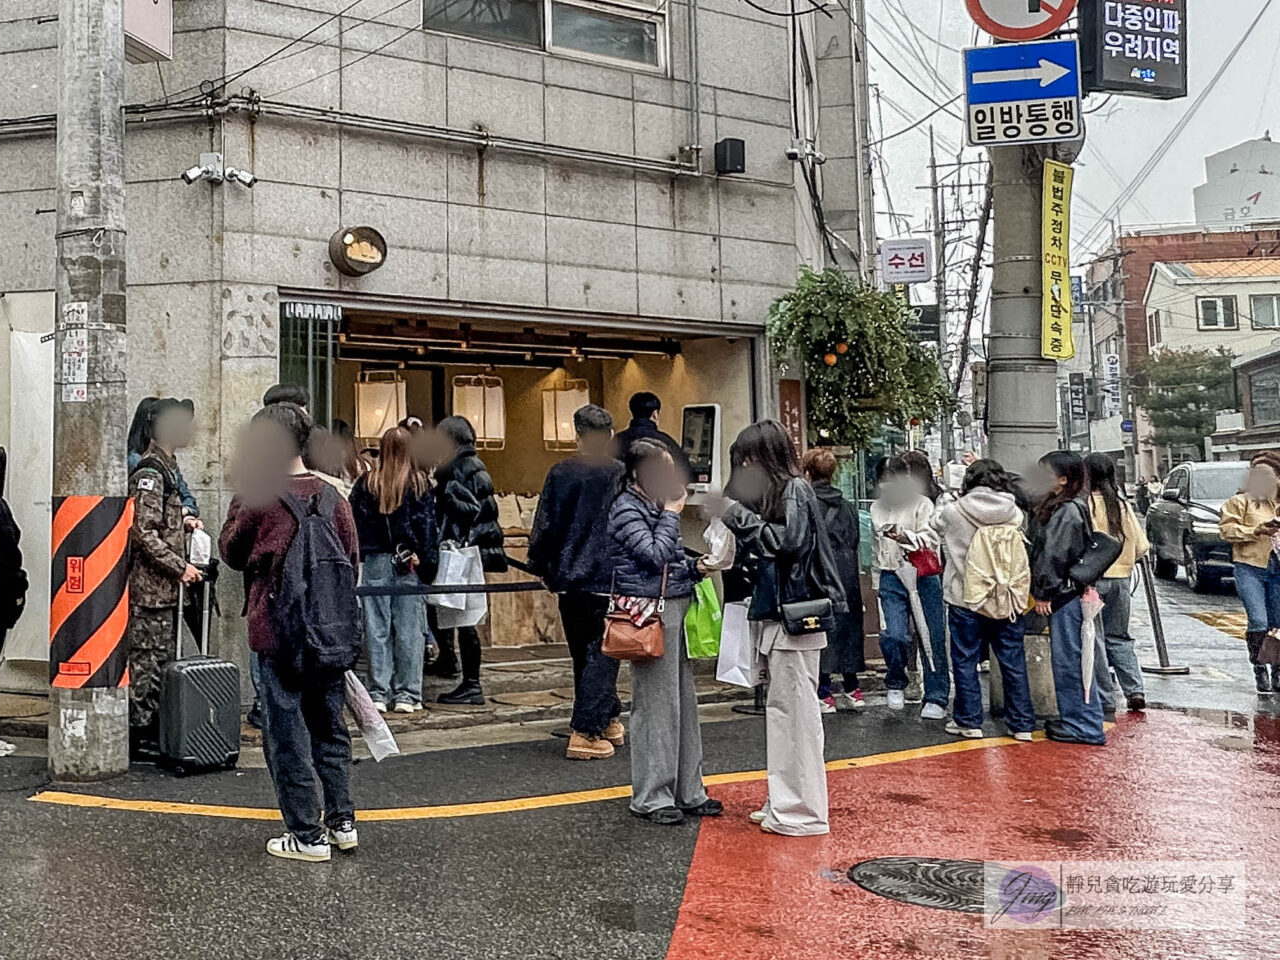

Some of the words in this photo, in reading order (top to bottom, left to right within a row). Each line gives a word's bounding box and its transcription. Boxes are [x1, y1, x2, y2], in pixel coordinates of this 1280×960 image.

[1104, 1, 1181, 35] 다중인파
[1104, 31, 1180, 65] 우려지역
[974, 100, 1074, 140] 일방통행
[1050, 168, 1066, 251] 불법주정차
[888, 252, 925, 269] 수선
[1045, 253, 1067, 268] CCTV
[69, 558, 82, 590] 위험
